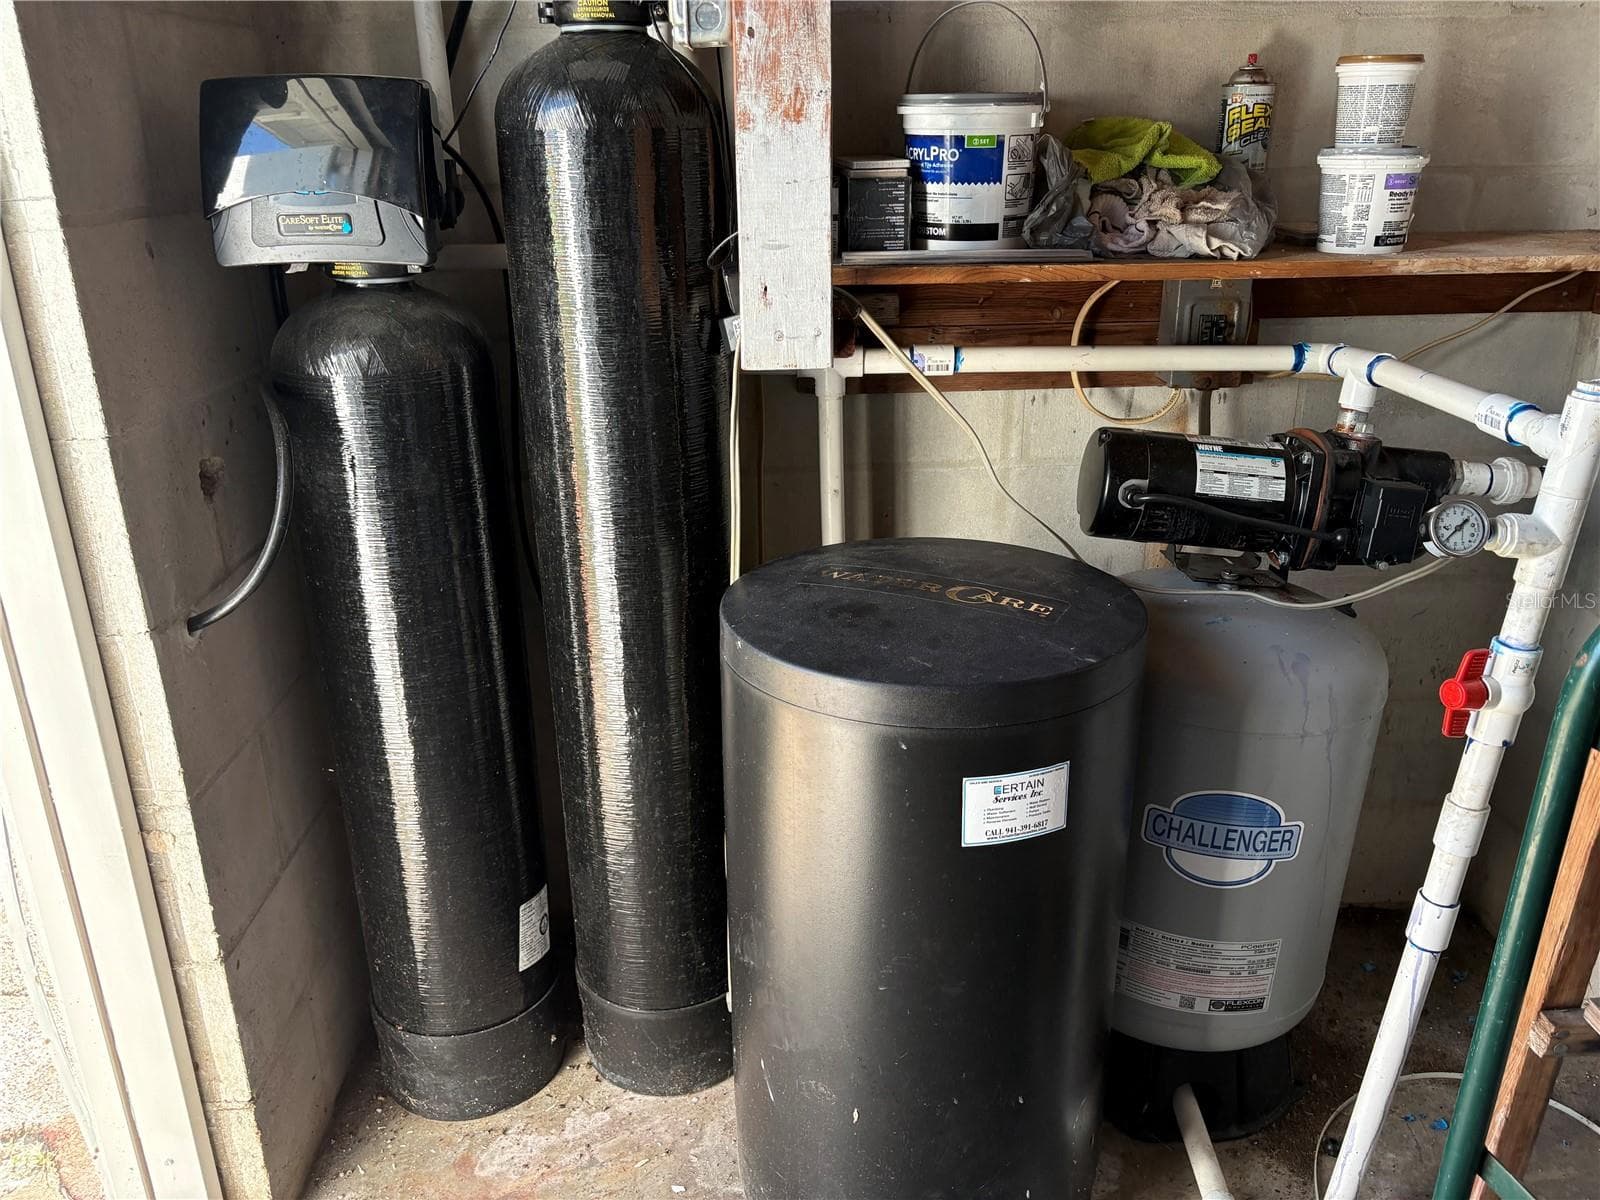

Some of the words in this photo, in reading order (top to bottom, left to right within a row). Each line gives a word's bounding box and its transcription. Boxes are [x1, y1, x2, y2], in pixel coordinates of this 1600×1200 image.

[1229, 103, 1273, 126] FLEX
[1388, 190, 1408, 198] Ready
[320, 214, 344, 225] ELITE
[1196, 443, 1224, 453] WAYNE
[993, 777, 1045, 796] CERTAIN
[992, 792, 1027, 805] Services
[984, 827, 1004, 838] CALL
[1004, 818, 1049, 835] 941-391-6817
[1152, 812, 1295, 854] CHALLENGER
[1226, 997, 1266, 1006] FLEXCON
